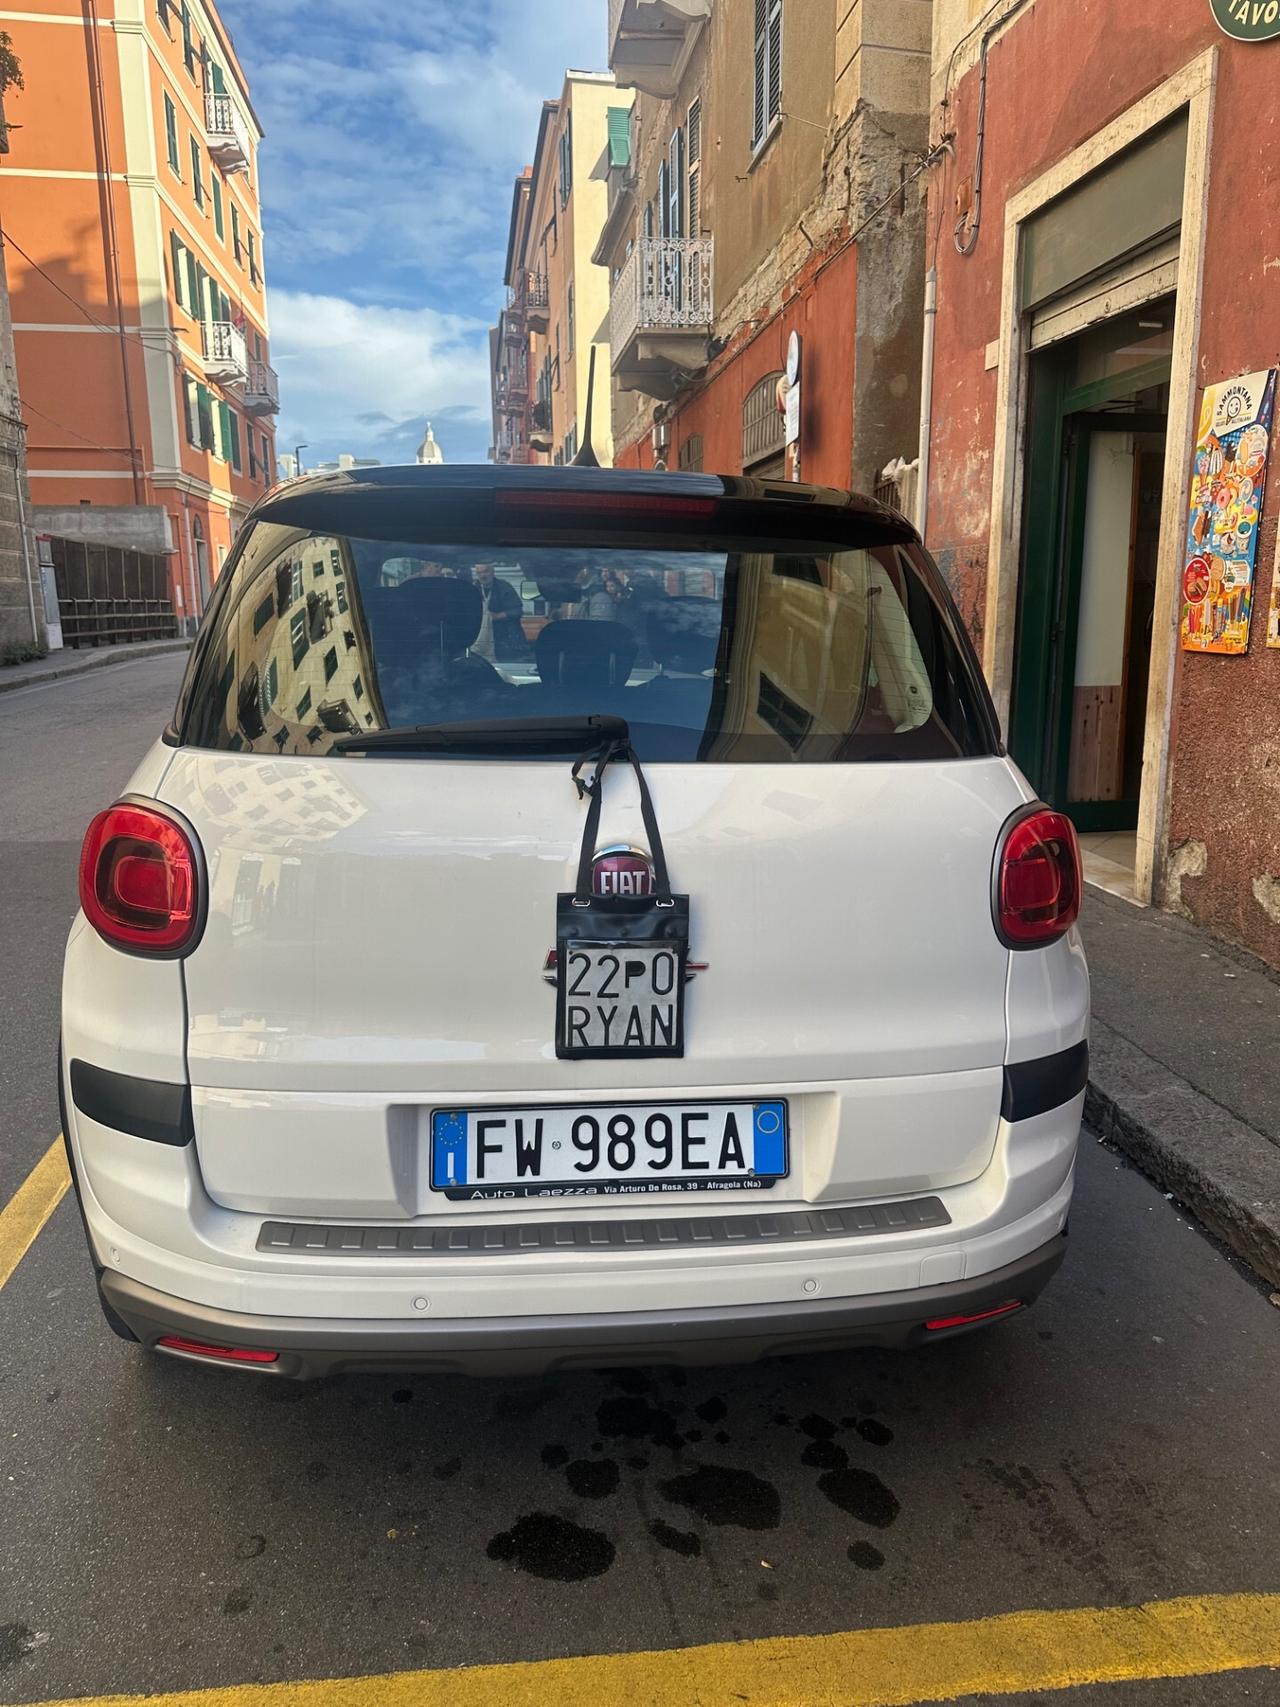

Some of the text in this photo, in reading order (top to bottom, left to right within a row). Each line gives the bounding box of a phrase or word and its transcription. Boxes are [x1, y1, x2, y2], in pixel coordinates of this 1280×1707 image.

[1217, 386, 1252, 416] SAMMONTANA
[600, 871, 646, 895] FIAT
[568, 1005, 674, 1047] RYAN
[470, 1190, 515, 1200] Auto
[524, 1186, 597, 1198] Laezza
[619, 1184, 646, 1193] Arturo
[649, 1184, 660, 1192] De
[662, 1183, 685, 1192] Rosa,
[687, 1182, 698, 1190] 39
[707, 1181, 741, 1190] Afragola
[743, 1180, 762, 1189] (Na)
